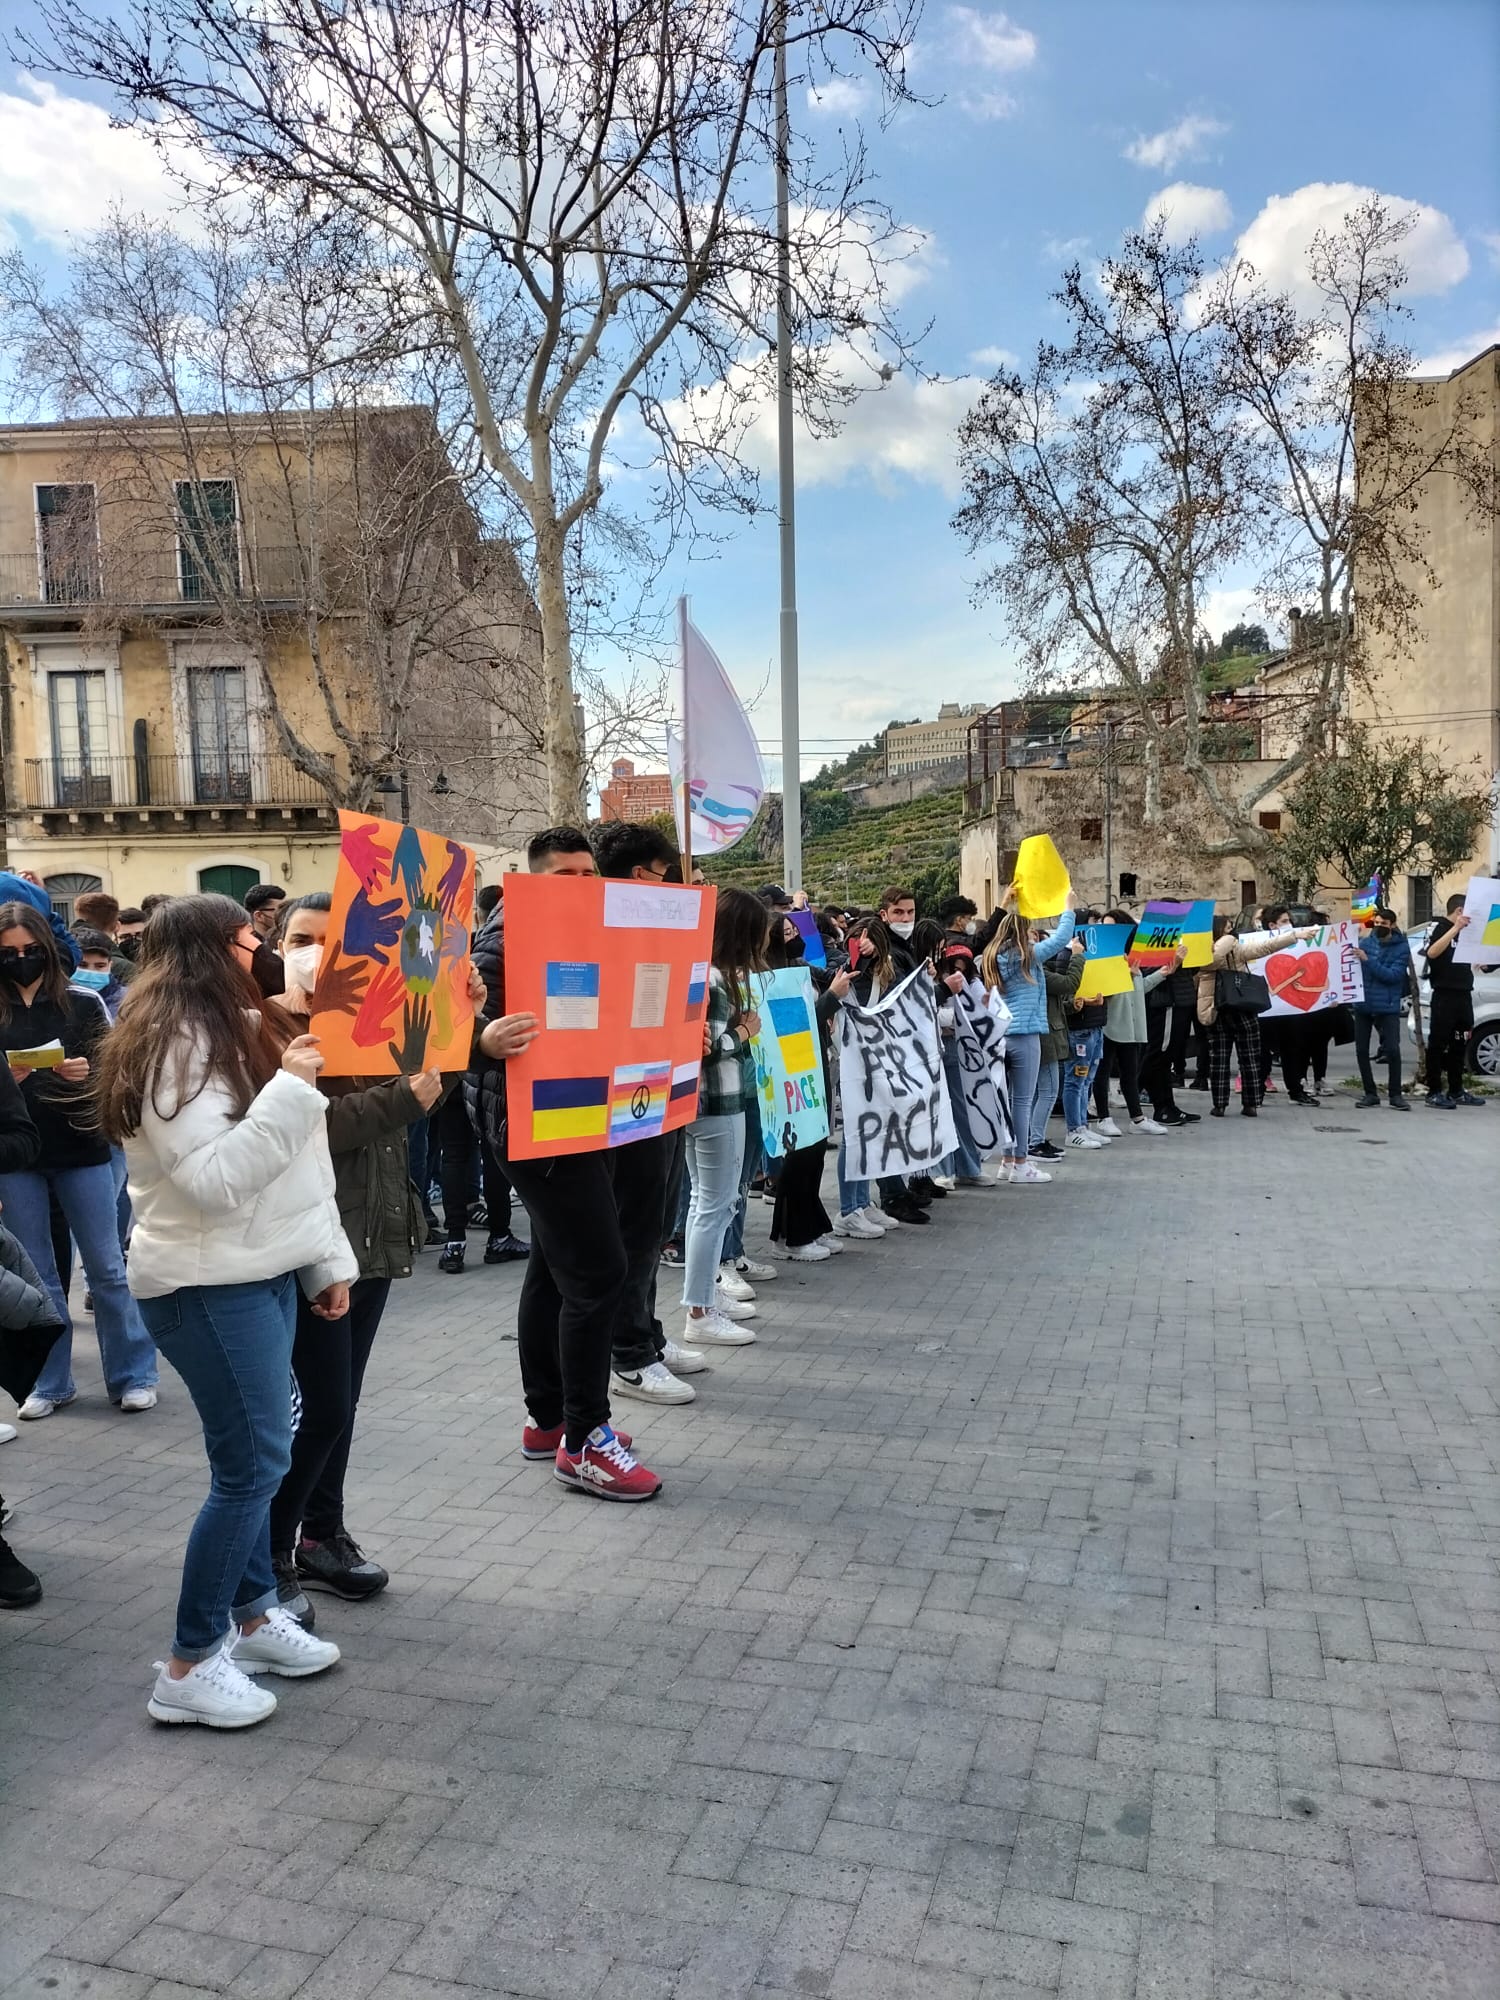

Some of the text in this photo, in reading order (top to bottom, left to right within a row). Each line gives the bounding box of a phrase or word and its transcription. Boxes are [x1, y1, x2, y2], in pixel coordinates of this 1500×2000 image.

[1146, 926, 1180, 948] PACE
[1304, 921, 1348, 948] WAR
[861, 1043, 923, 1102] PER
[784, 1074, 820, 1115] PACE
[858, 1091, 942, 1176] PACE
